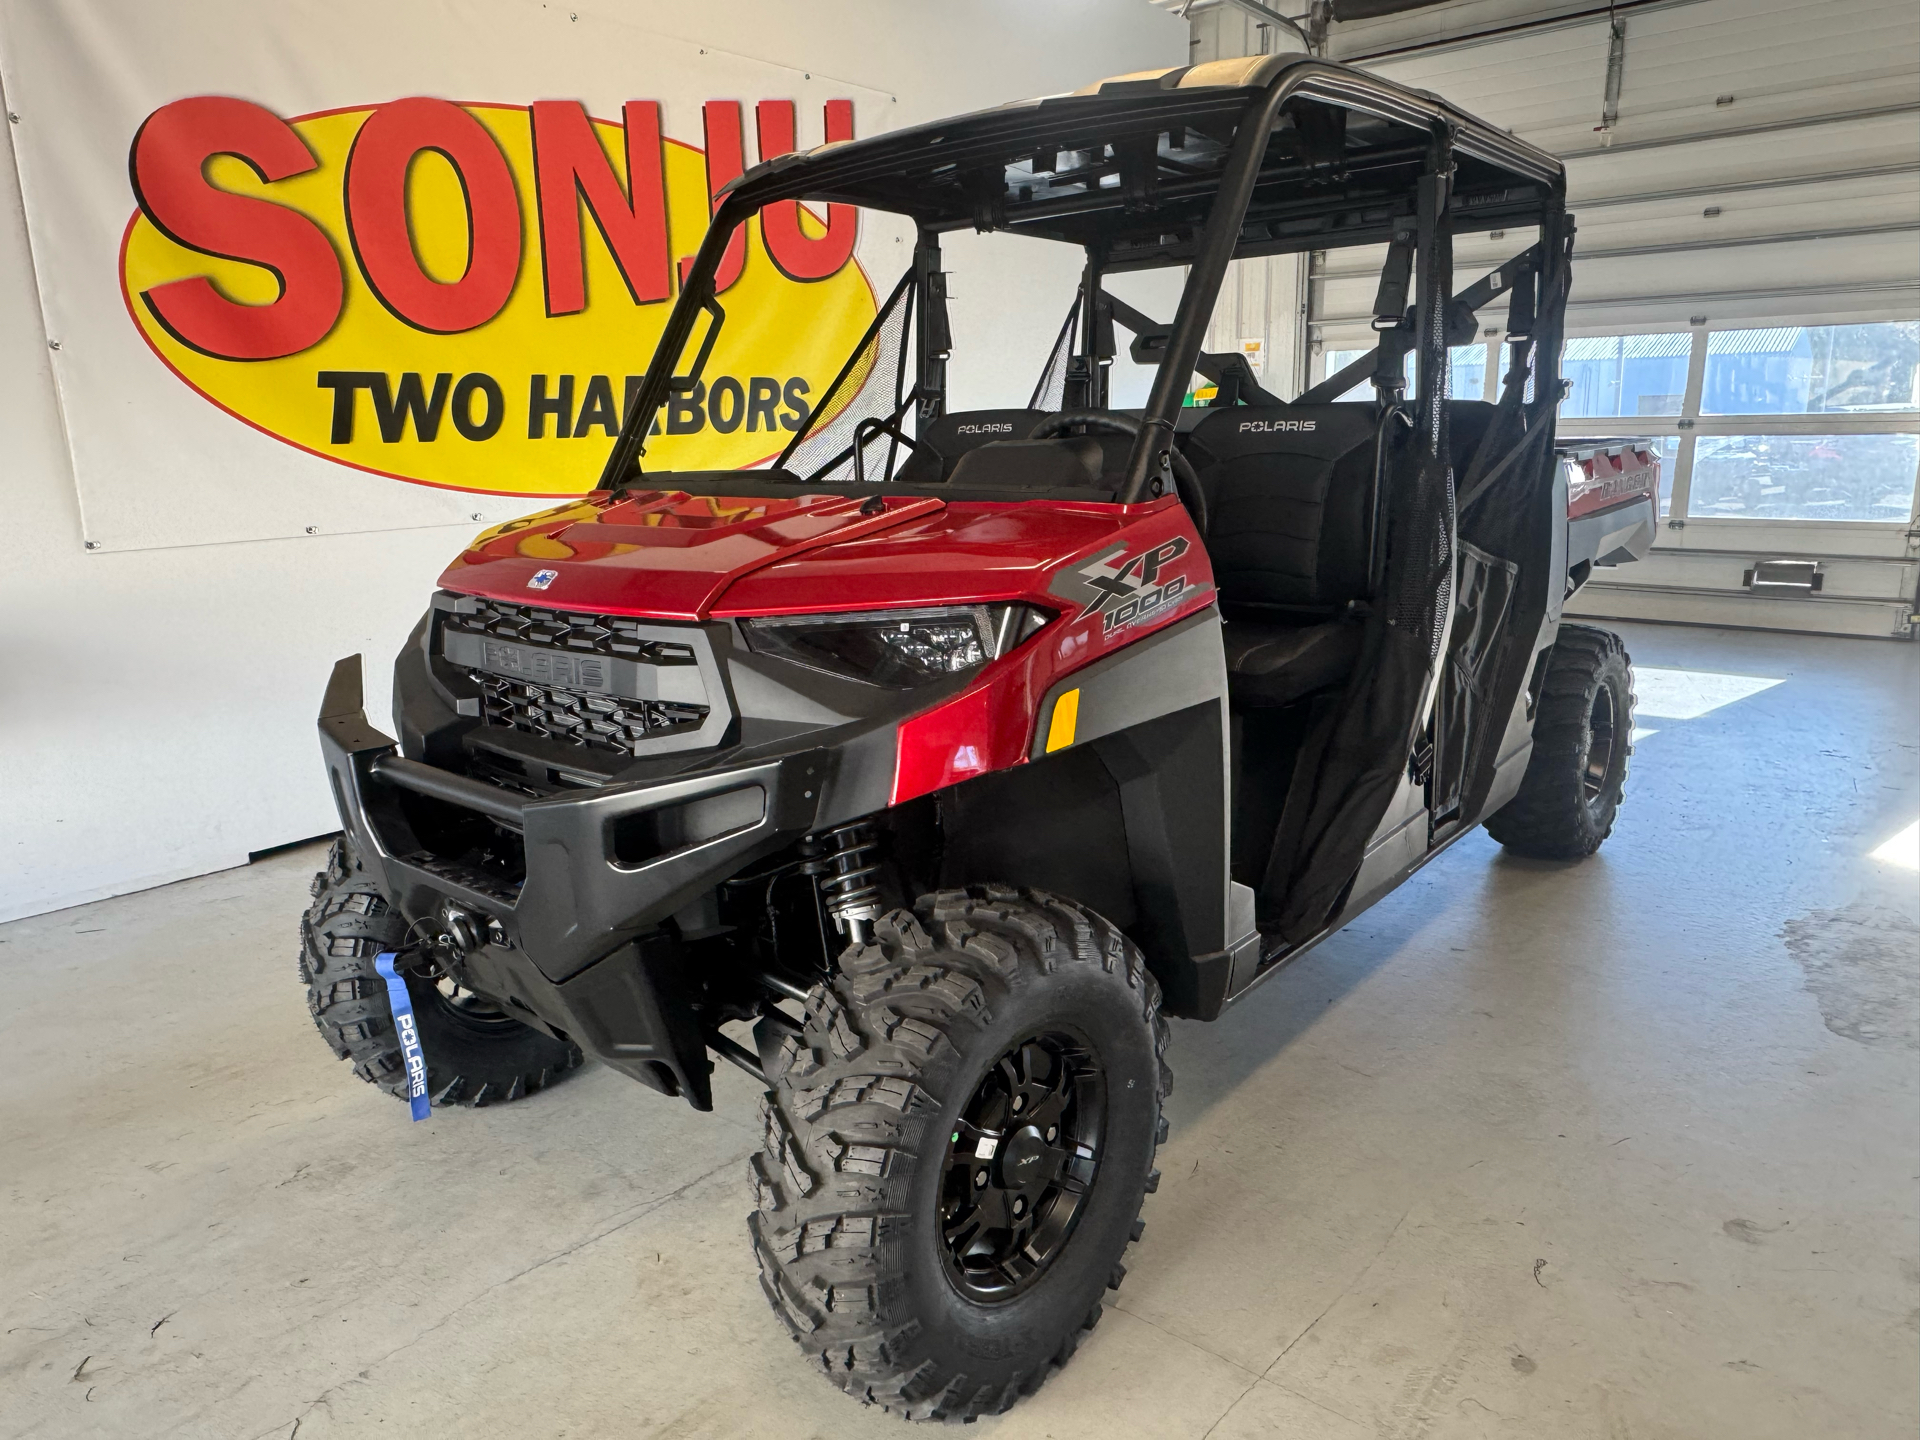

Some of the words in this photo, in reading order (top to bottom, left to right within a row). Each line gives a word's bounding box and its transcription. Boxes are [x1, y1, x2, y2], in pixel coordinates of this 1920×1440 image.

[129, 96, 857, 362] SONJU
[318, 370, 504, 445] TWO
[957, 422, 1013, 435] POLARIS
[1239, 420, 1317, 433] POLARIS
[1070, 535, 1191, 626] XP
[1103, 574, 1187, 635] 1000
[483, 642, 604, 687] POLARIS
[397, 1013, 426, 1098] POLARIS
[1017, 1155, 1040, 1167] XP
